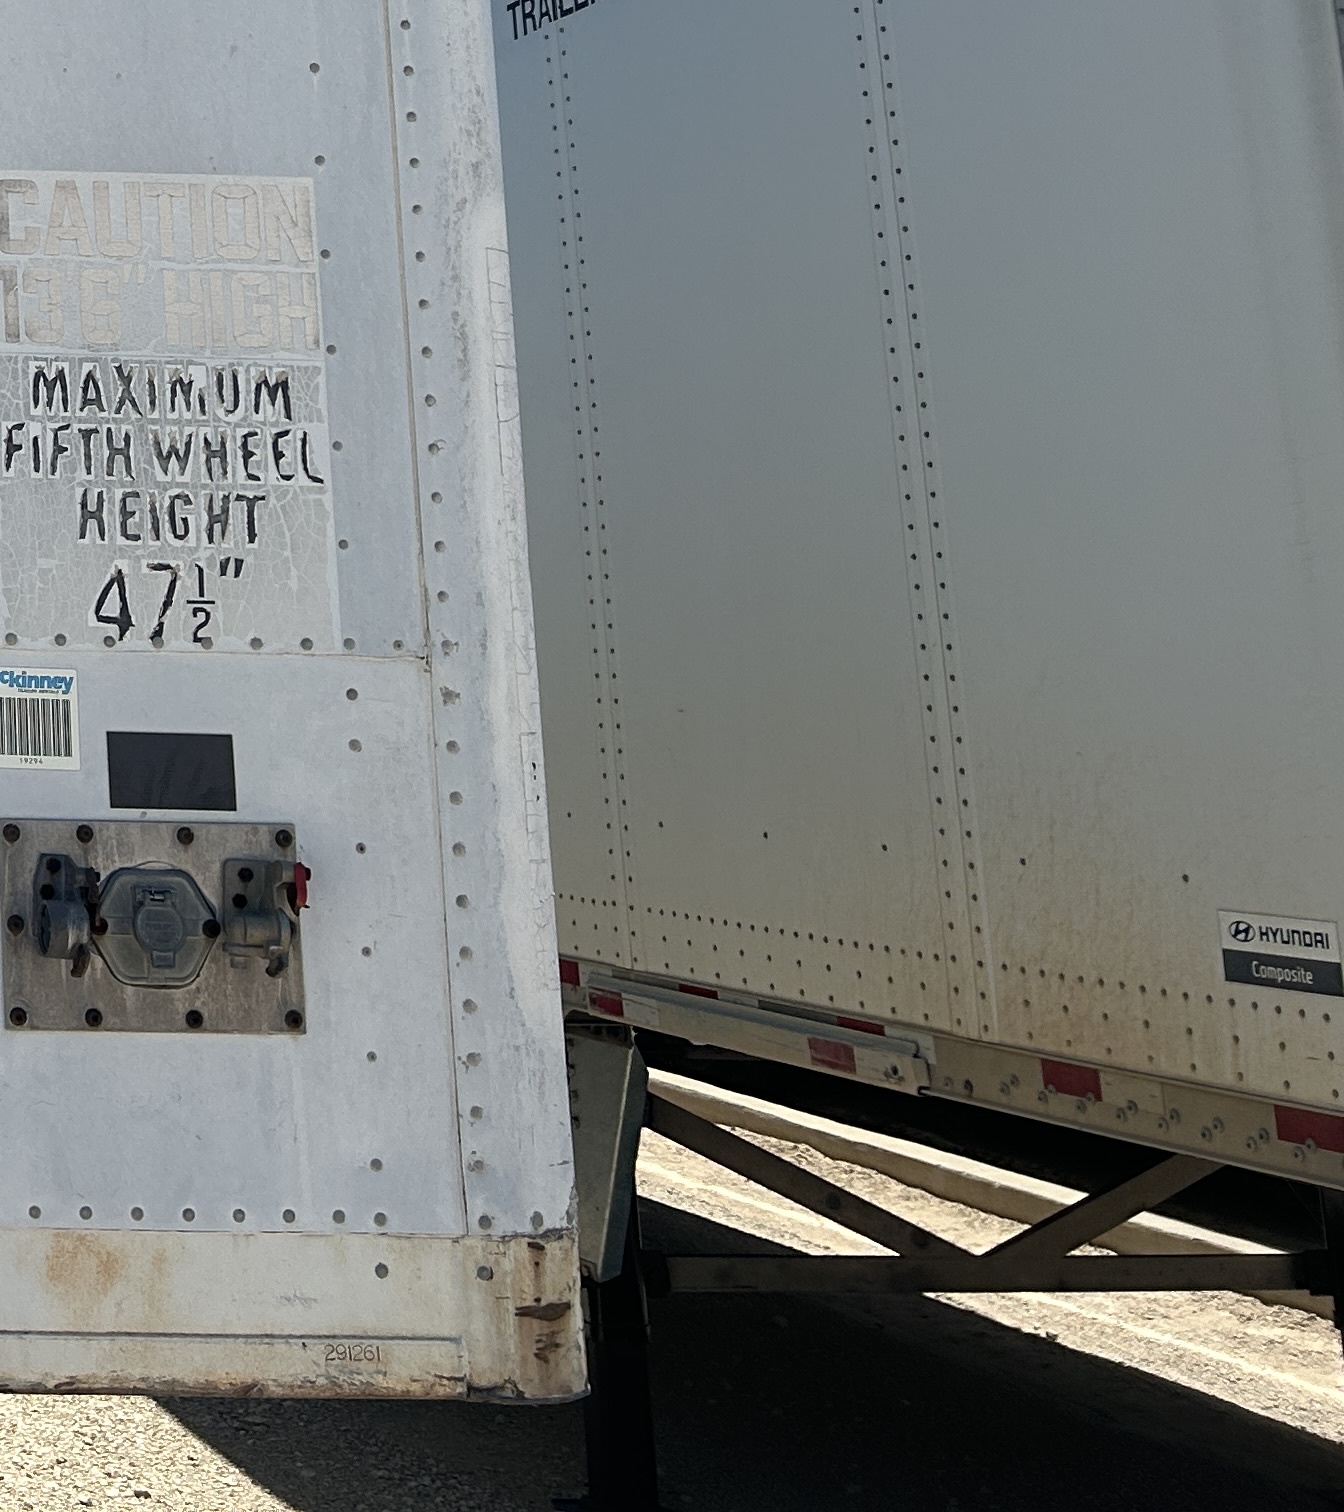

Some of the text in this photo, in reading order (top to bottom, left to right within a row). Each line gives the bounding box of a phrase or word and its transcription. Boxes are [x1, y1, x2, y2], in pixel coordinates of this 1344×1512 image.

[161, 269, 321, 350] HIGH
[31, 362, 293, 422] MAXIMUM
[3, 422, 325, 485] FIFTH WHEEL
[77, 487, 267, 545] HEIGHT
[19, 757, 44, 765] 19294
[1258, 924, 1331, 950] HYUNDAI
[1250, 960, 1314, 985] Composite
[323, 1343, 381, 1362] 291261
